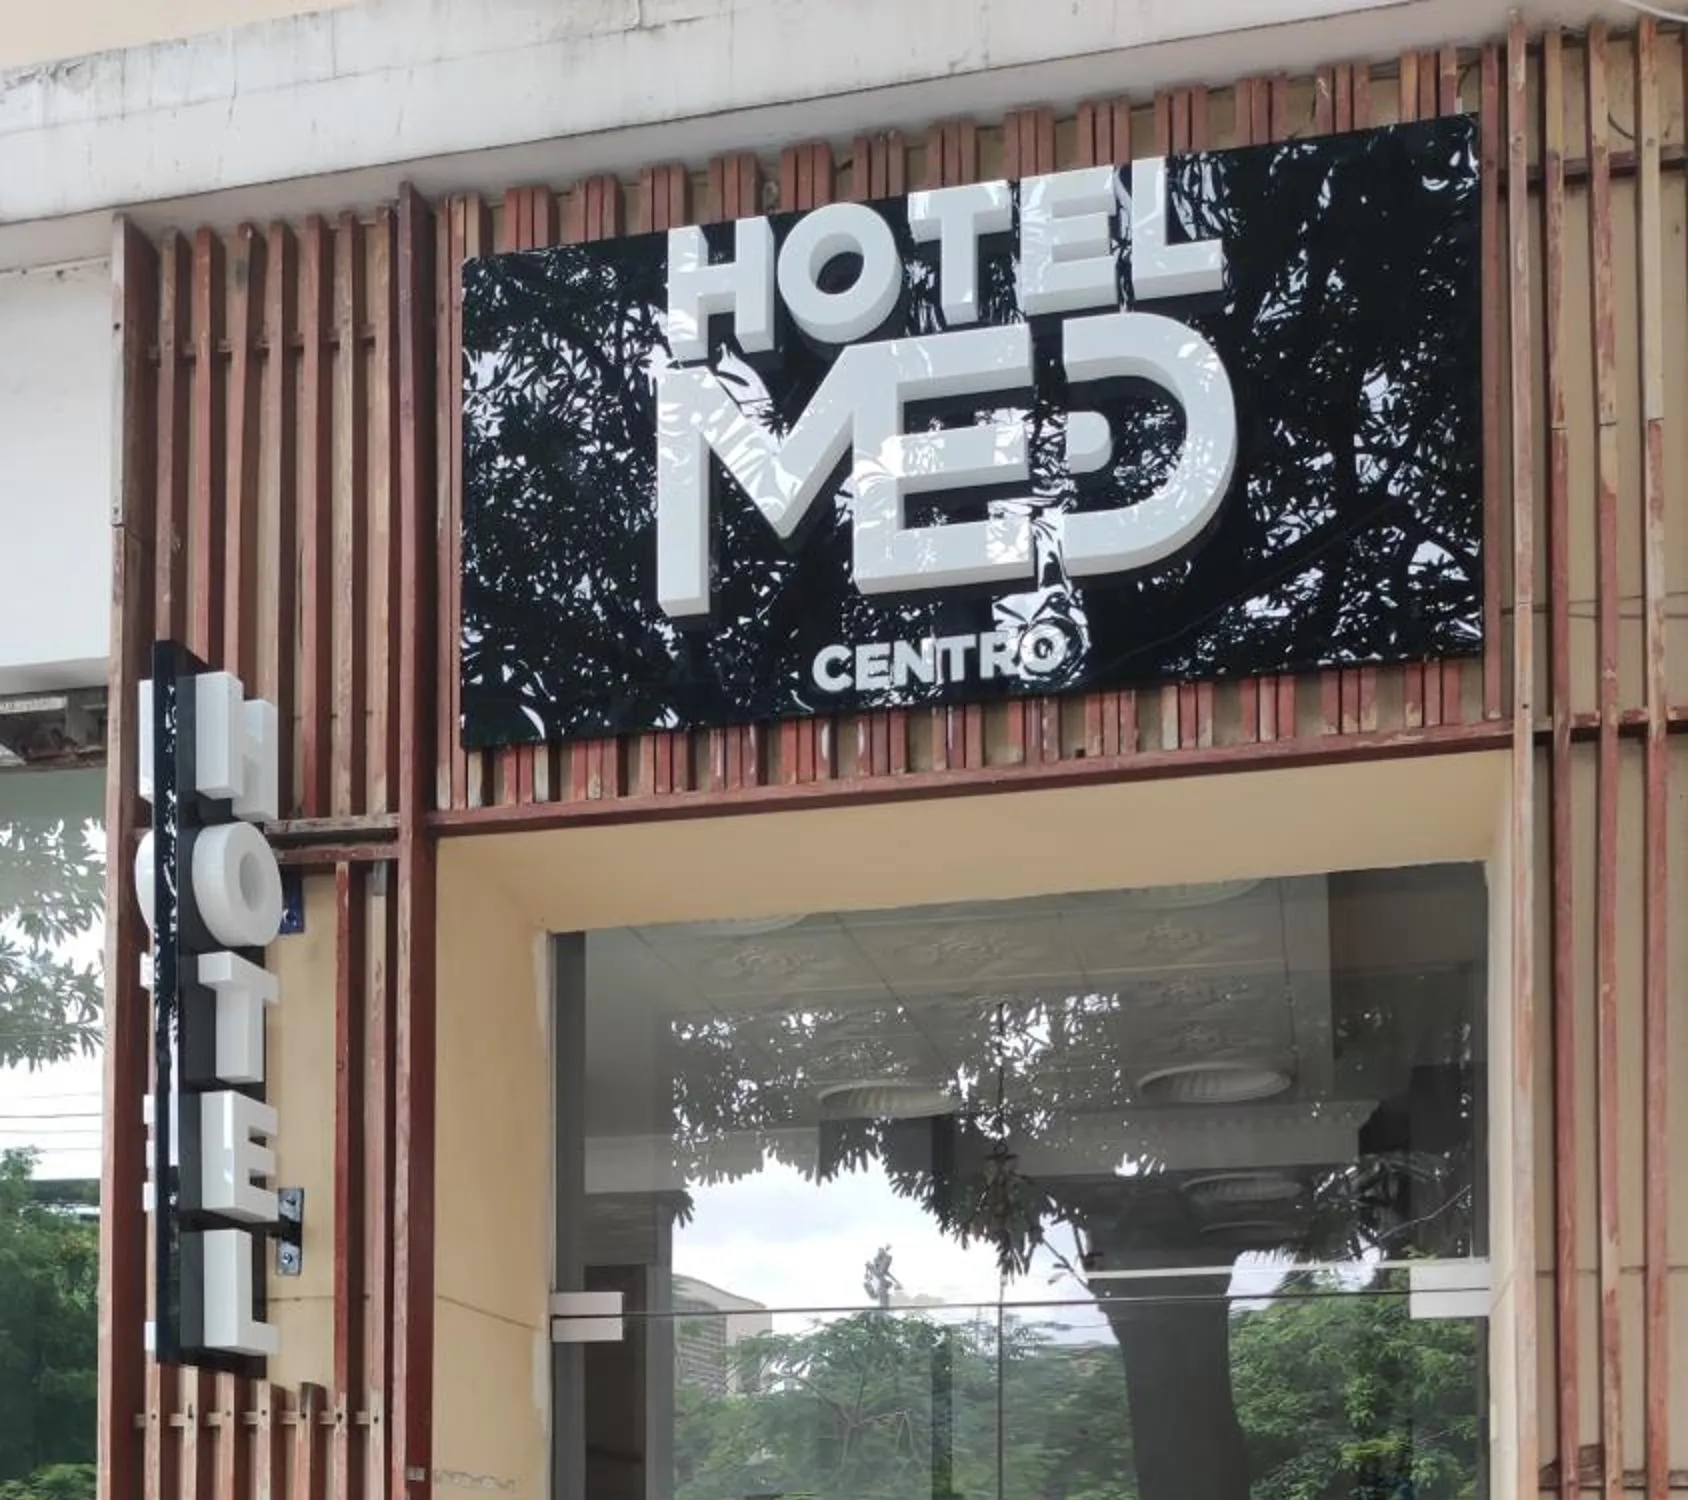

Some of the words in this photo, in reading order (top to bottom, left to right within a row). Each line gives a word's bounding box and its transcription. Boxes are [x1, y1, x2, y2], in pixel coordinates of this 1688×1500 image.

[667, 156, 1223, 362] HOTEL
[656, 311, 1236, 618] MED
[812, 626, 1069, 694] CENTRO
[192, 670, 284, 1356] HOTEL
